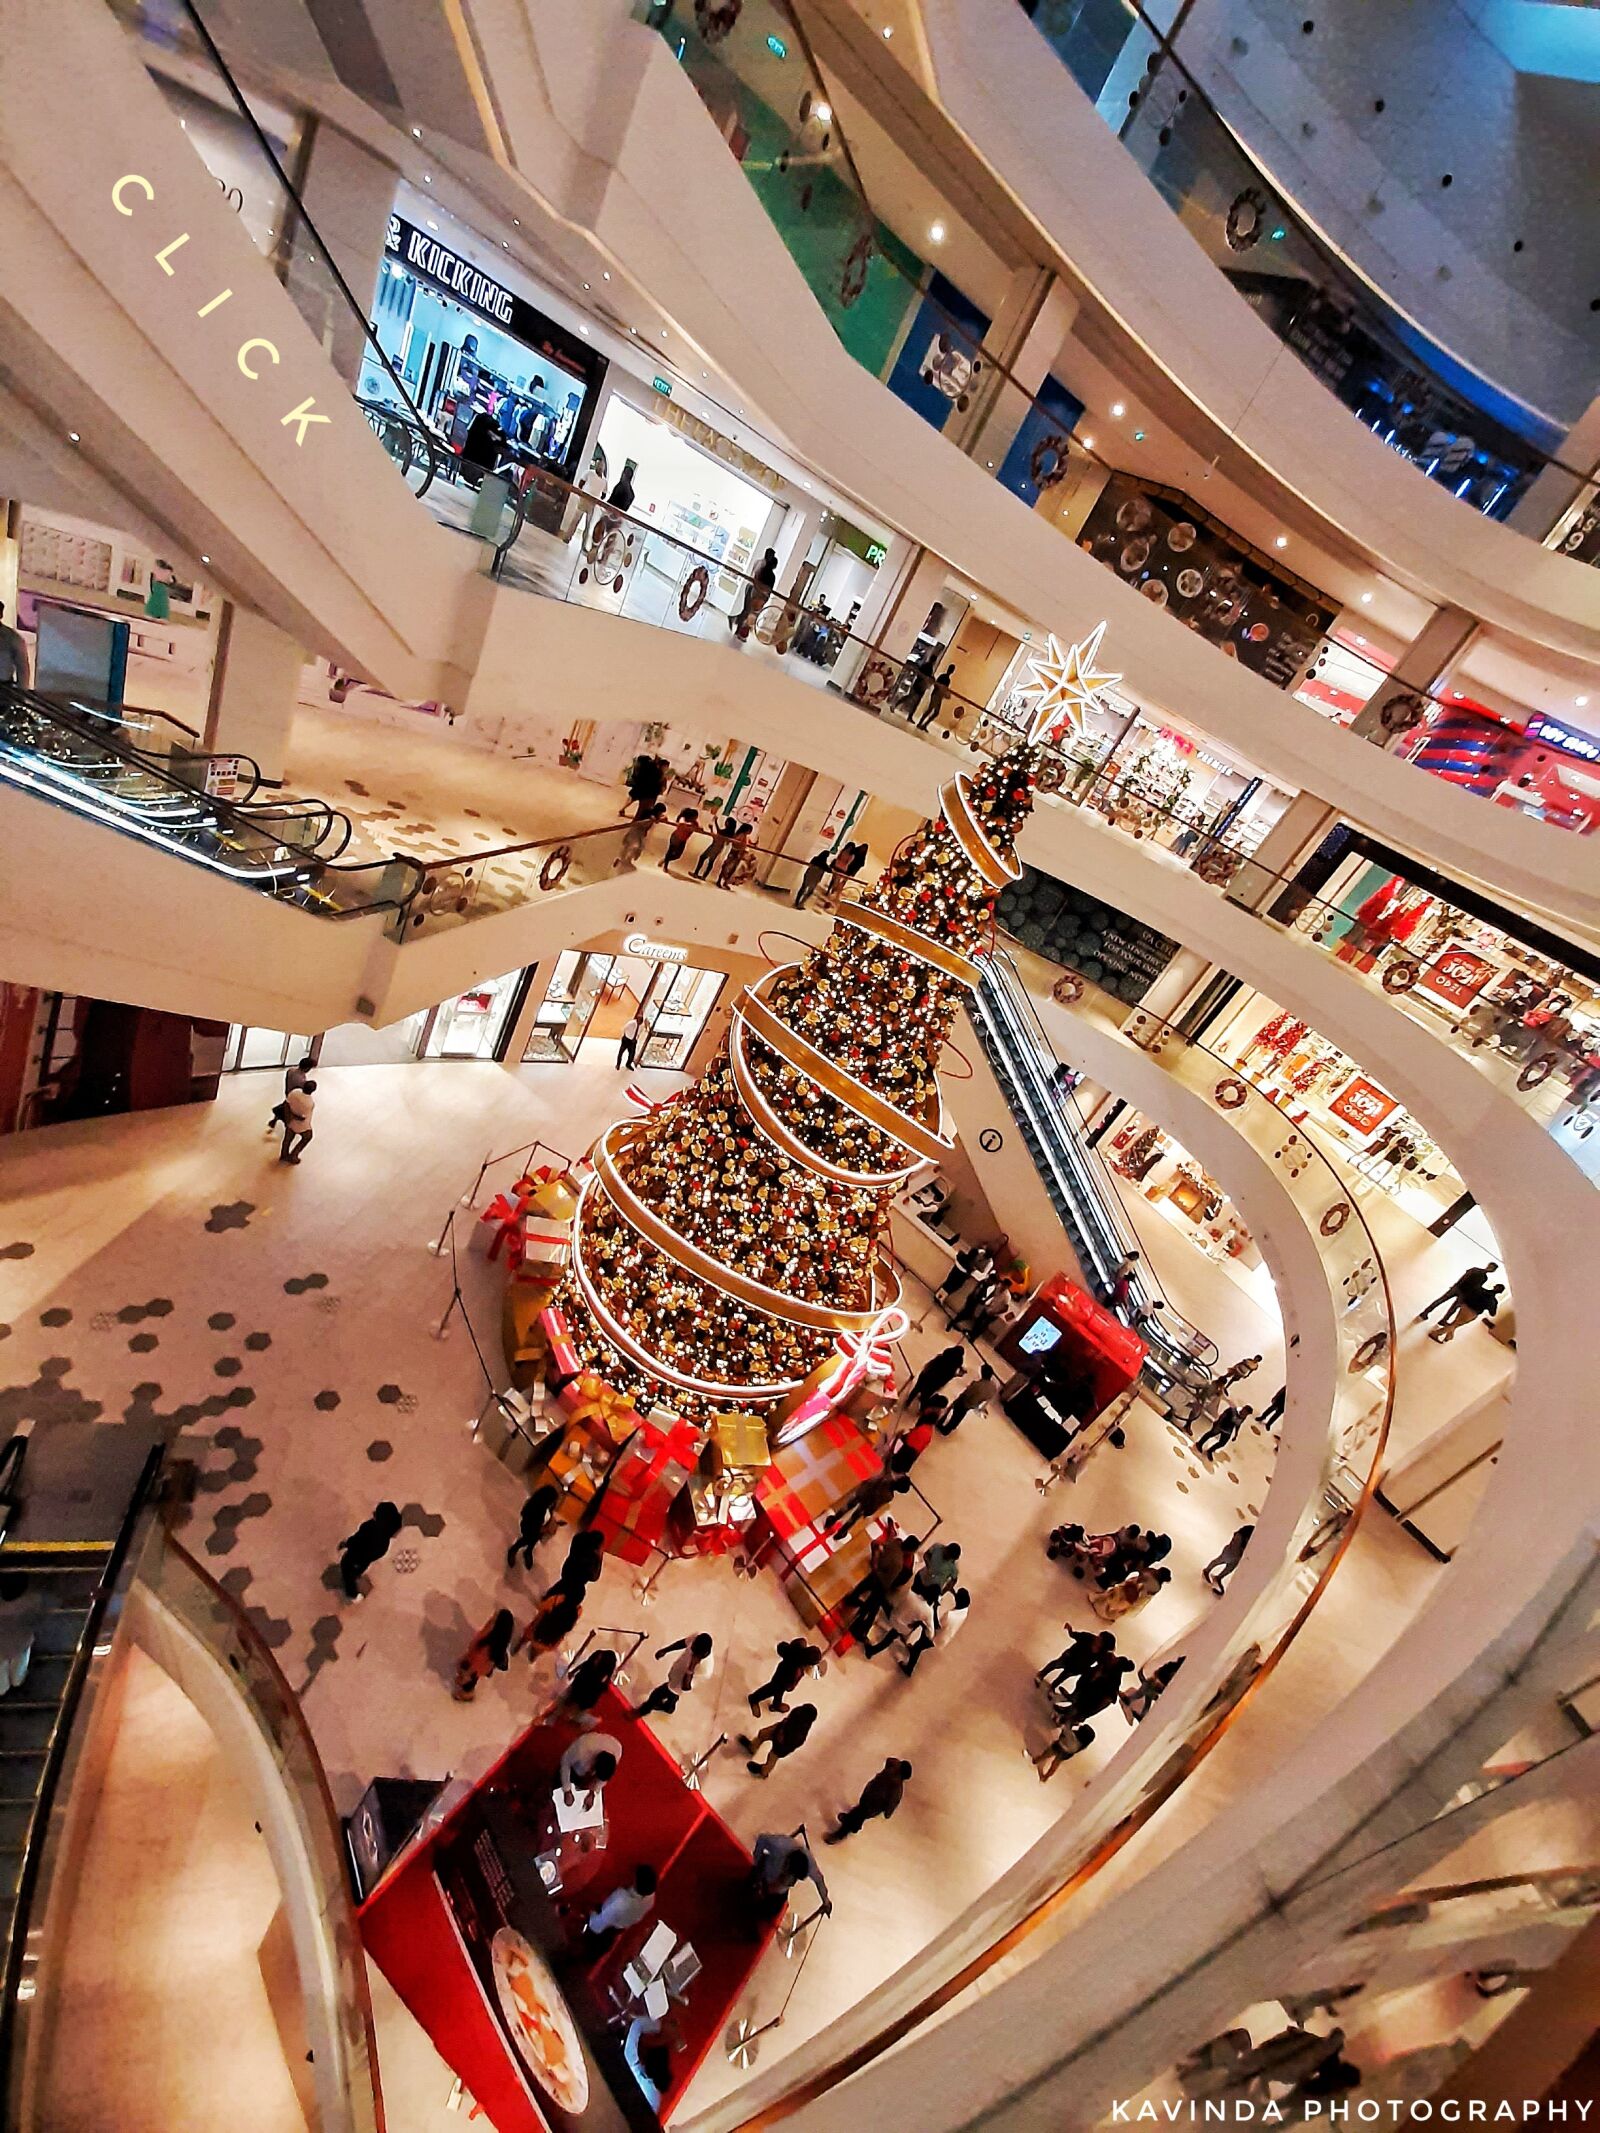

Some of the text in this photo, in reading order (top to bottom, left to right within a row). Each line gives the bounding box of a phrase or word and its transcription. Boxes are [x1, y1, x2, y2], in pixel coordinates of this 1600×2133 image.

[407, 231, 514, 324] KICKING
[1104, 941, 1120, 954] FOR
[1435, 975, 1463, 996] ODEL
